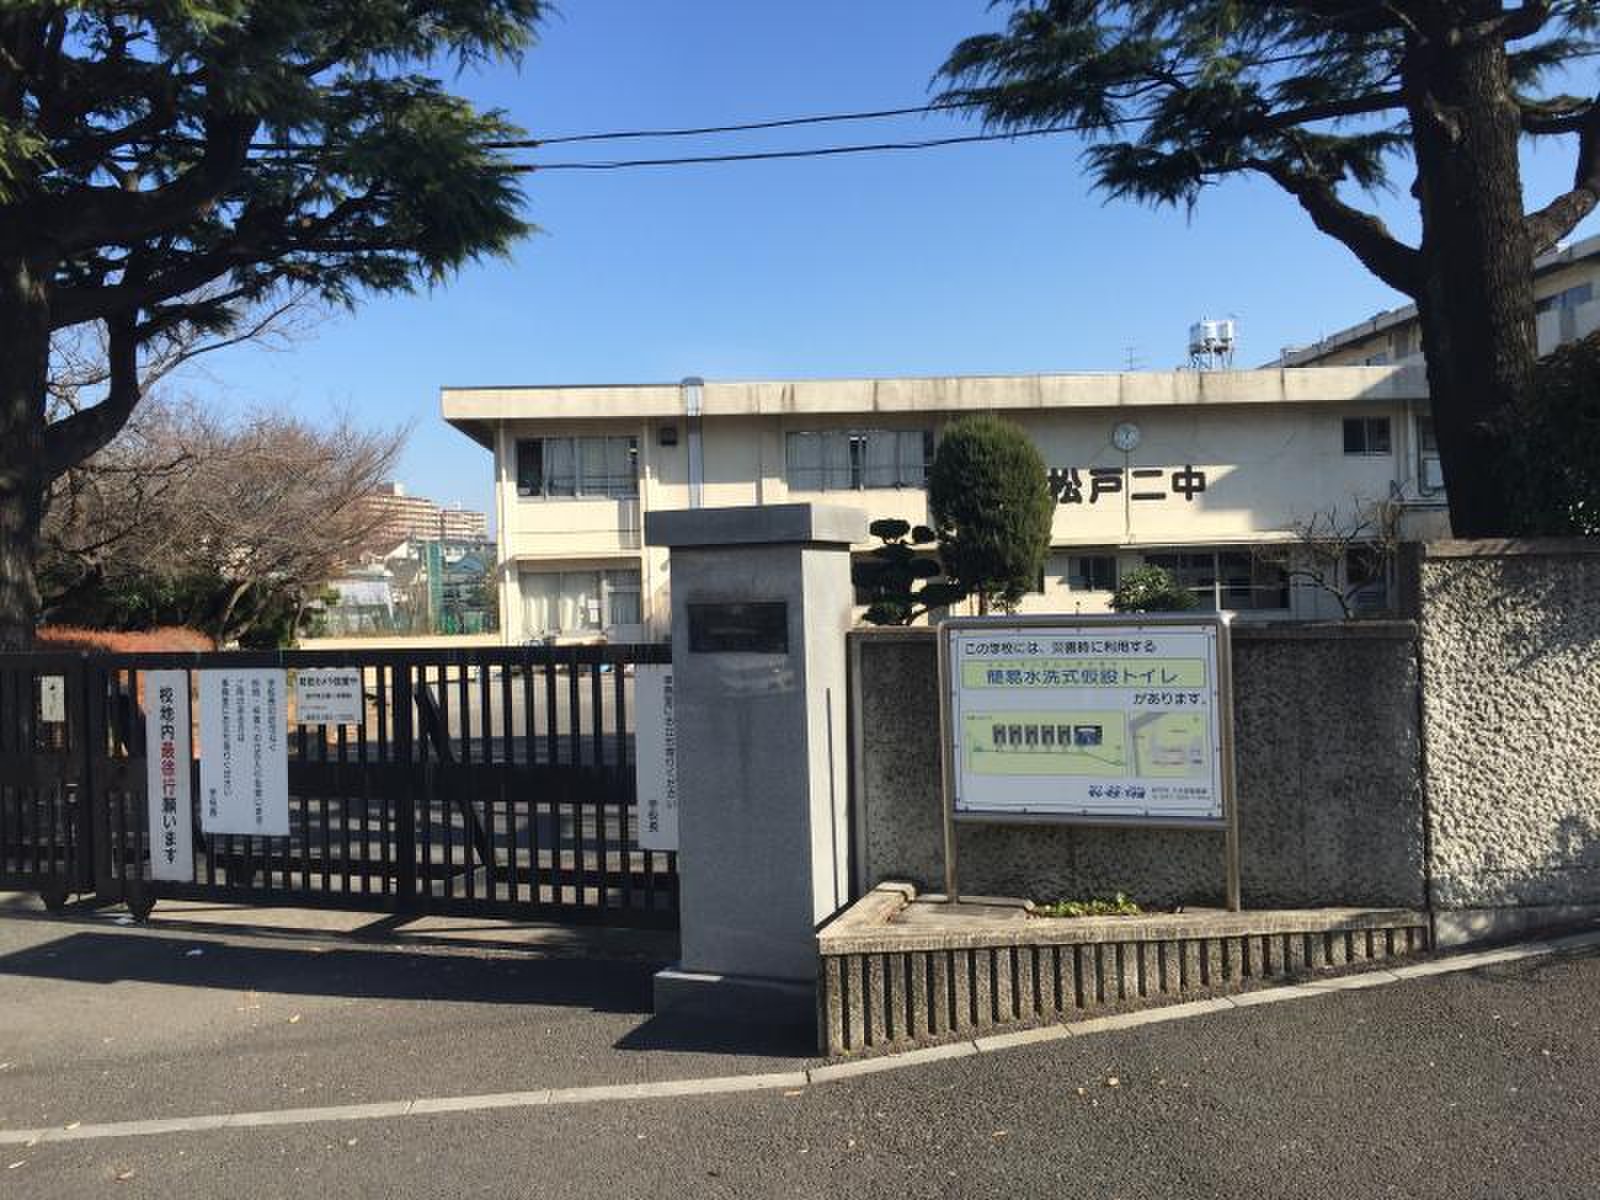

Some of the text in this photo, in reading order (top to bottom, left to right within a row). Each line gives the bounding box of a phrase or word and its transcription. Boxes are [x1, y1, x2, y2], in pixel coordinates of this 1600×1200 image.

[1048, 464, 1206, 504] 松戸二中
[964, 640, 1157, 656] この学校には、災害時に利用する
[986, 667, 1179, 685] 簡易水洗式仮設トイレ
[1132, 692, 1207, 705] があります。
